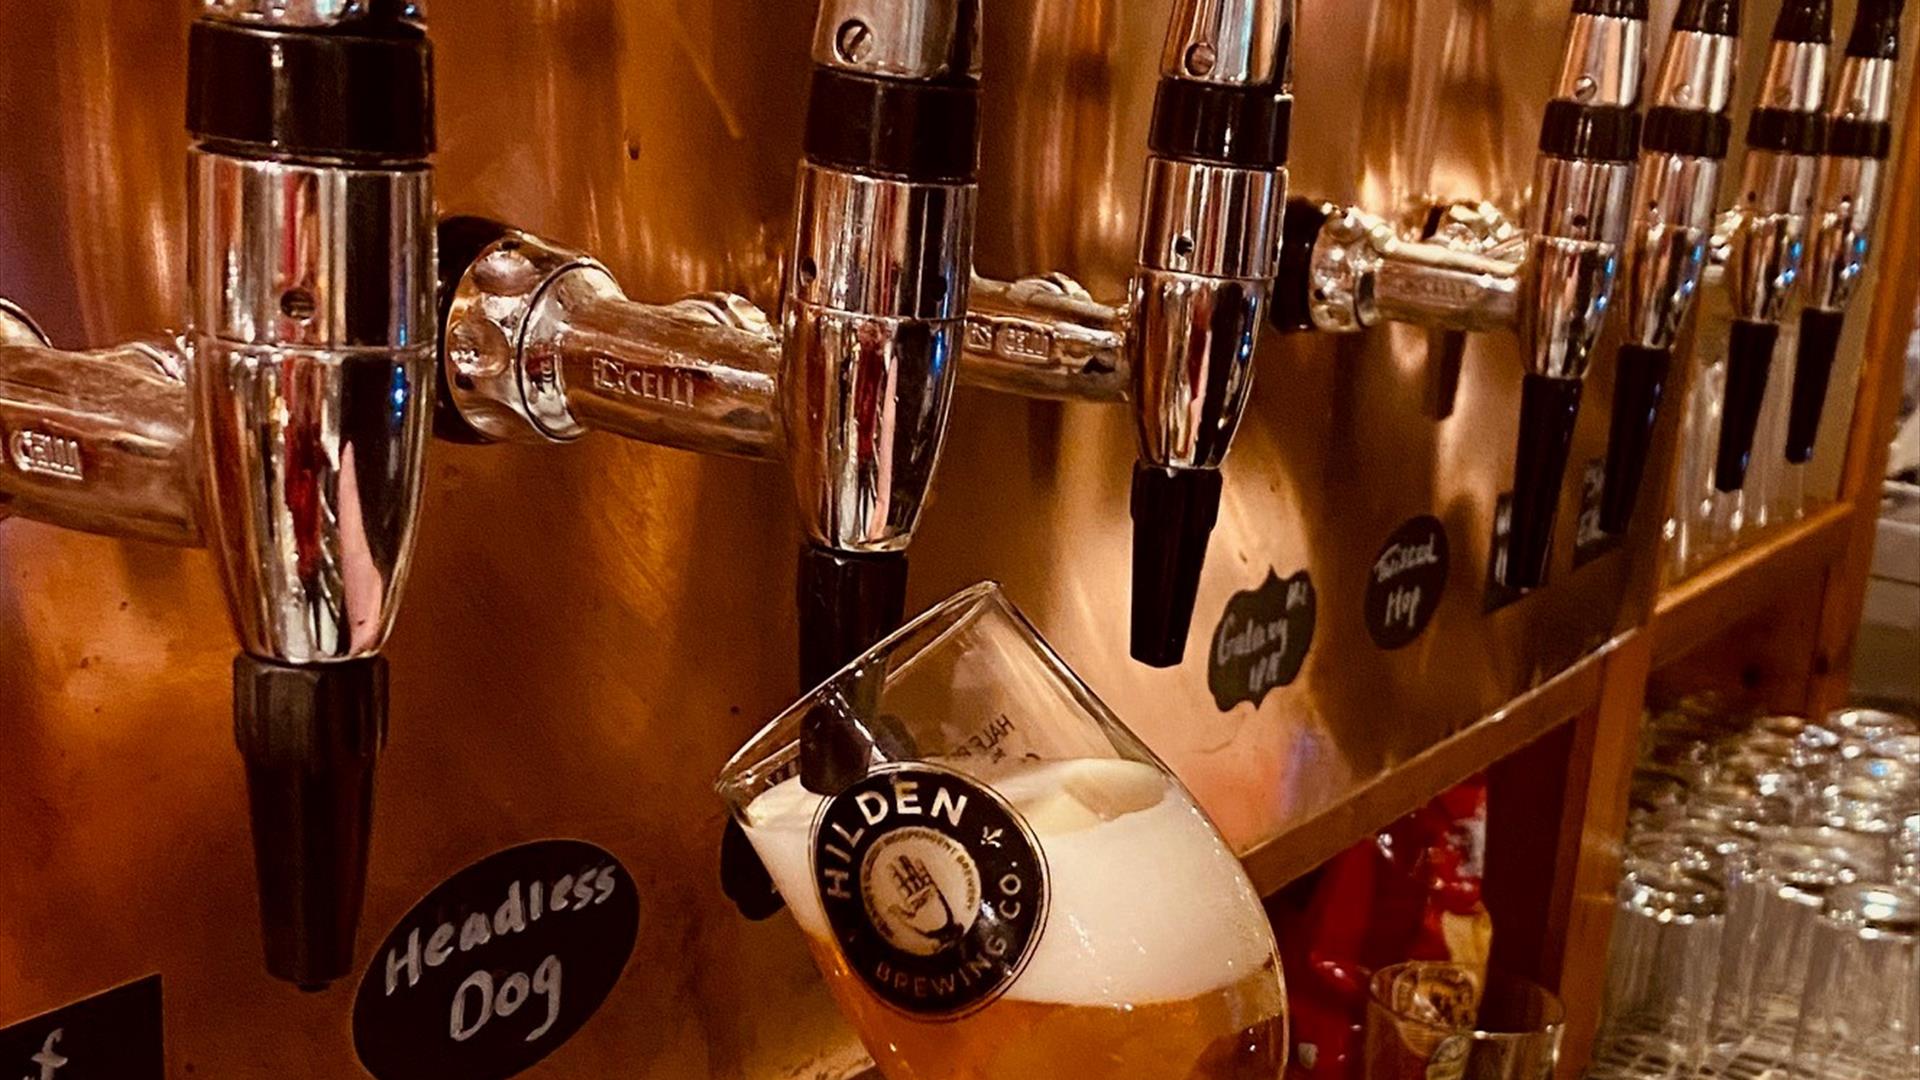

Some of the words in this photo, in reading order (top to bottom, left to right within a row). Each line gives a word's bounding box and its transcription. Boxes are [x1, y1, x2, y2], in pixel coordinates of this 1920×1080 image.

[625, 367, 694, 408] CELLI
[823, 779, 968, 900] HILDEN
[385, 864, 617, 996] Headless
[874, 933, 1008, 997] BREWING
[998, 860, 1023, 920] CO.
[449, 953, 562, 1042] Dog
